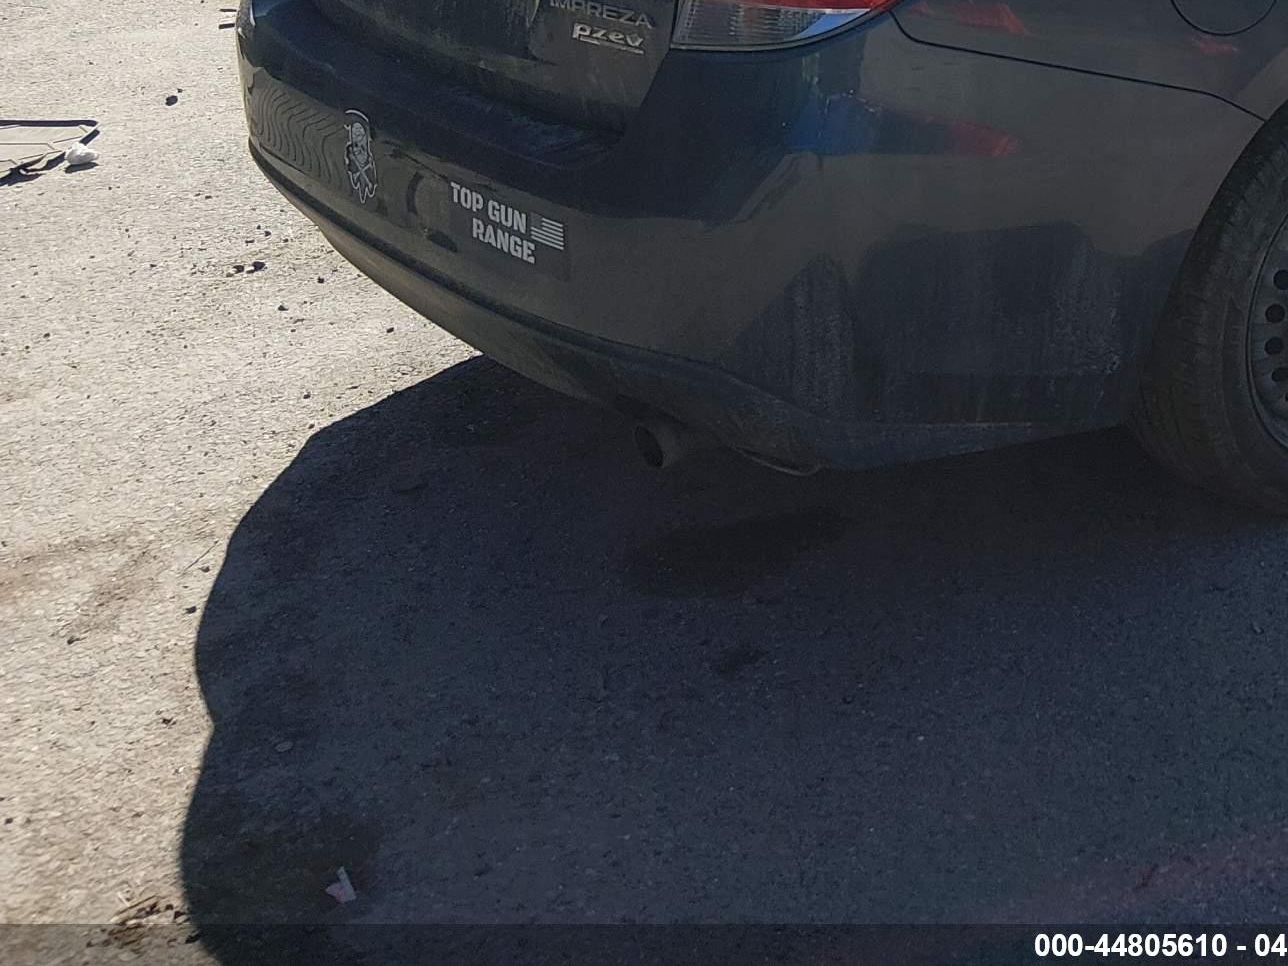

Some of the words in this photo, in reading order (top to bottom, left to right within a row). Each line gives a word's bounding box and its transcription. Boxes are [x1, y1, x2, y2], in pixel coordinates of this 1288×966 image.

[450, 181, 484, 213] TOP
[487, 199, 527, 234] GUN
[472, 217, 536, 264] RANGE
